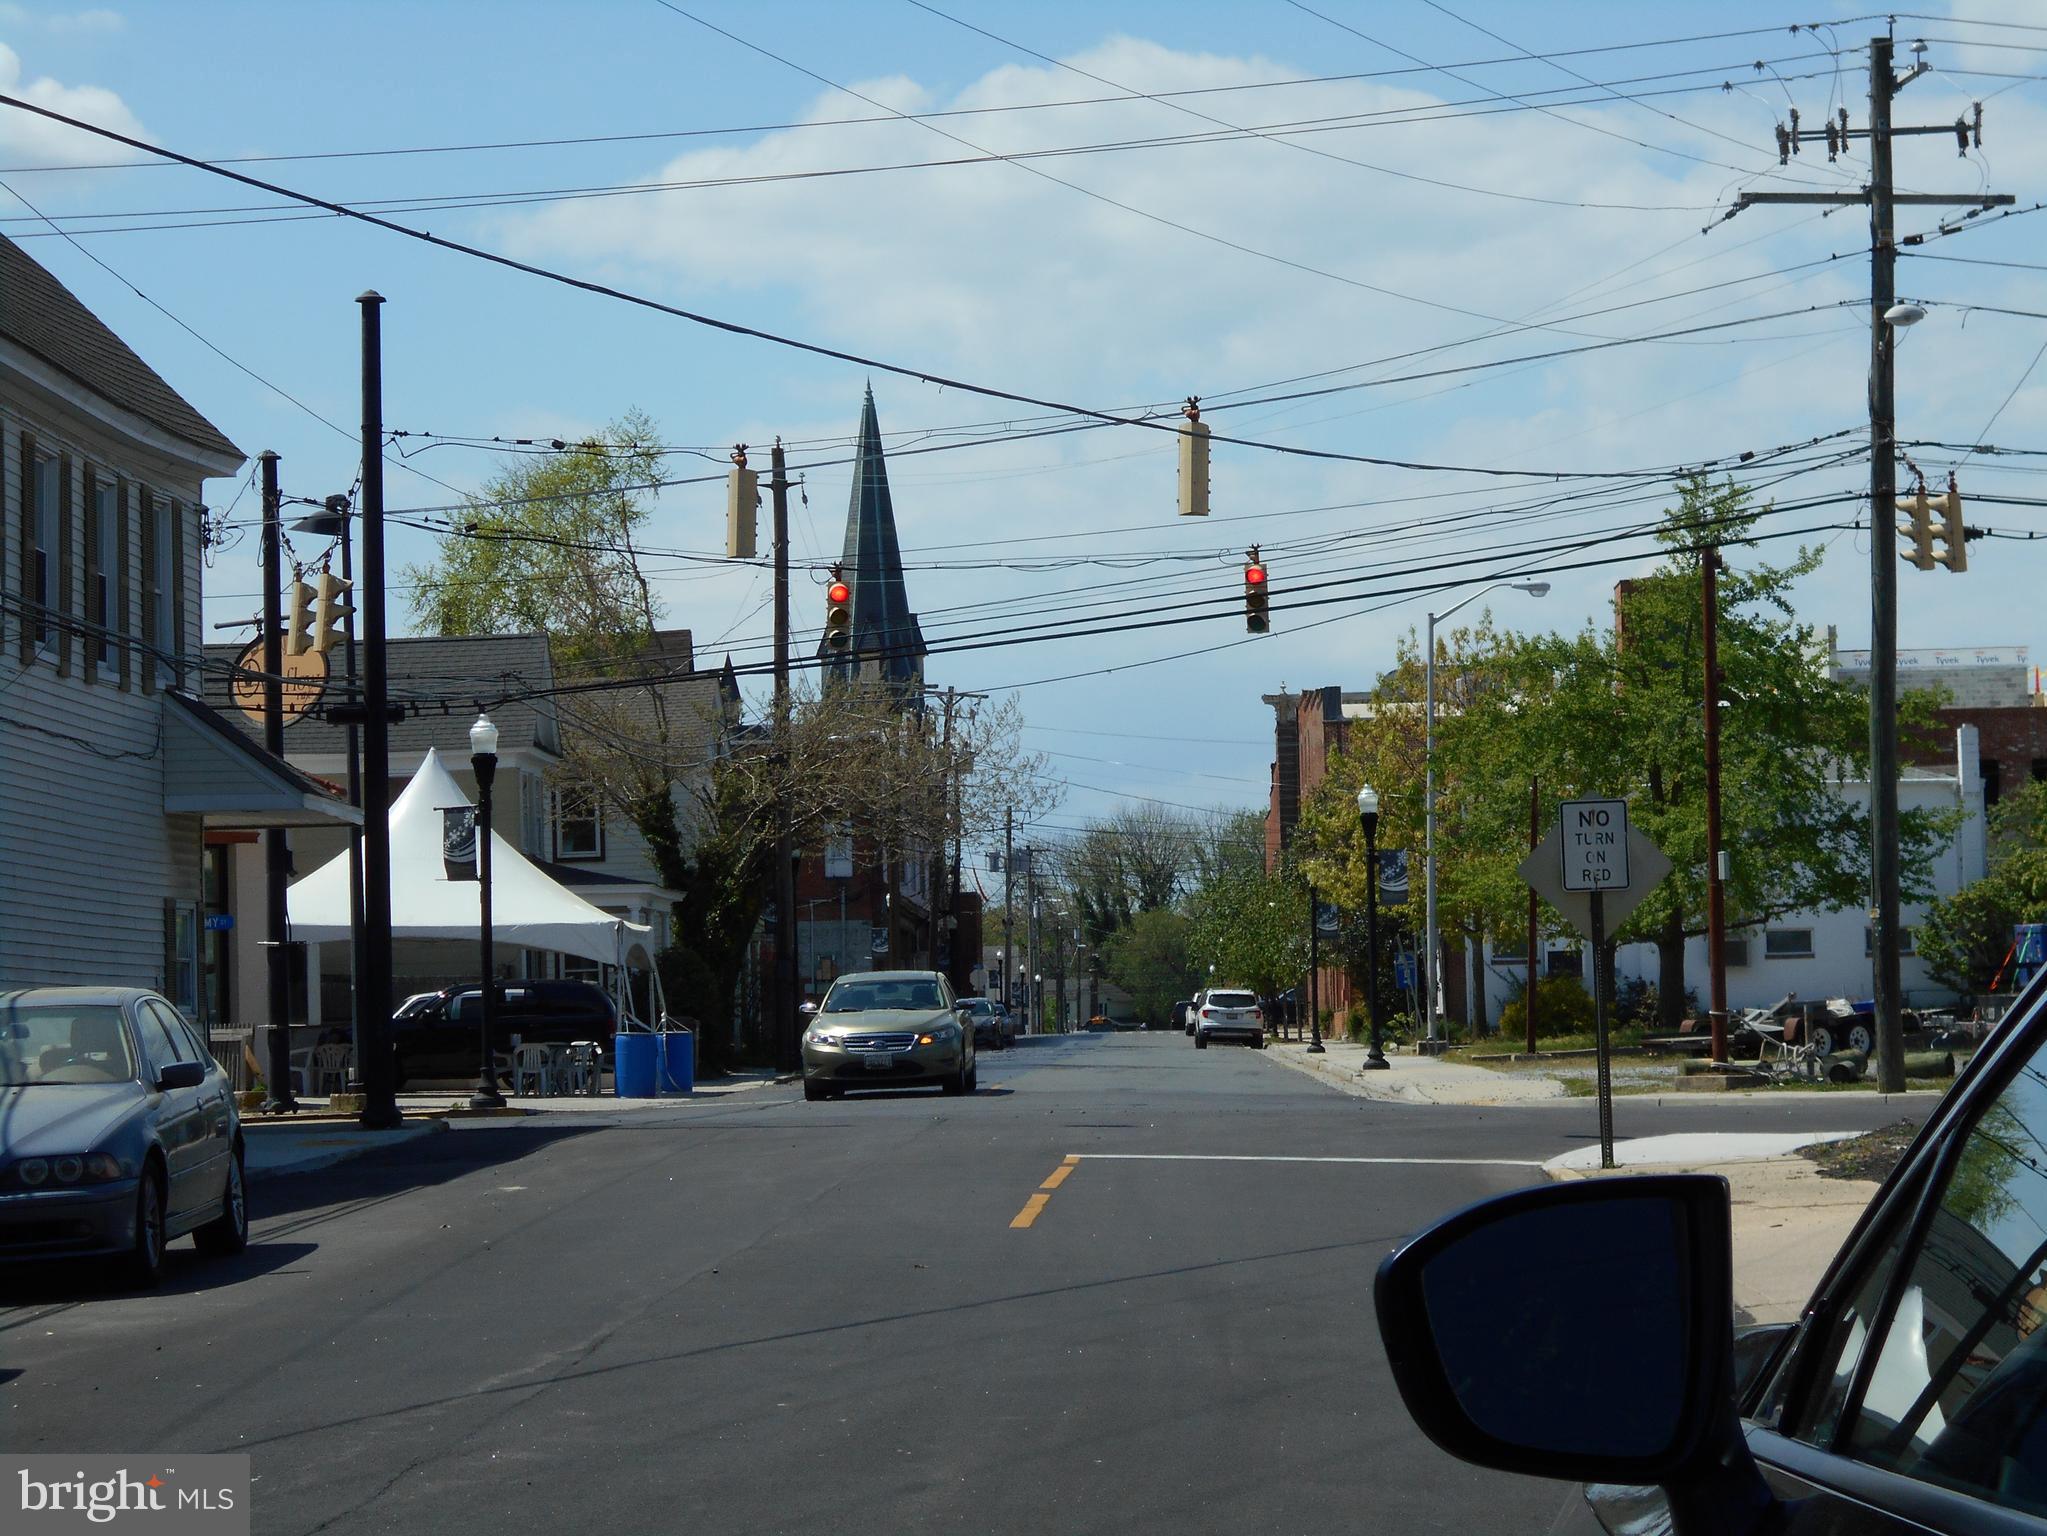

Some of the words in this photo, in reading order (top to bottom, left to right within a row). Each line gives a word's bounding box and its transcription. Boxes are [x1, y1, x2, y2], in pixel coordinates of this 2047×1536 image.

[1854, 658, 1873, 667] Tyve
[1935, 656, 1960, 665] Tyvek
[1976, 655, 2000, 664] Tyvek
[1579, 810, 1610, 828] NO
[1575, 832, 1614, 846] TURN
[1586, 850, 1606, 864] ON
[1582, 868, 1611, 882] RED
